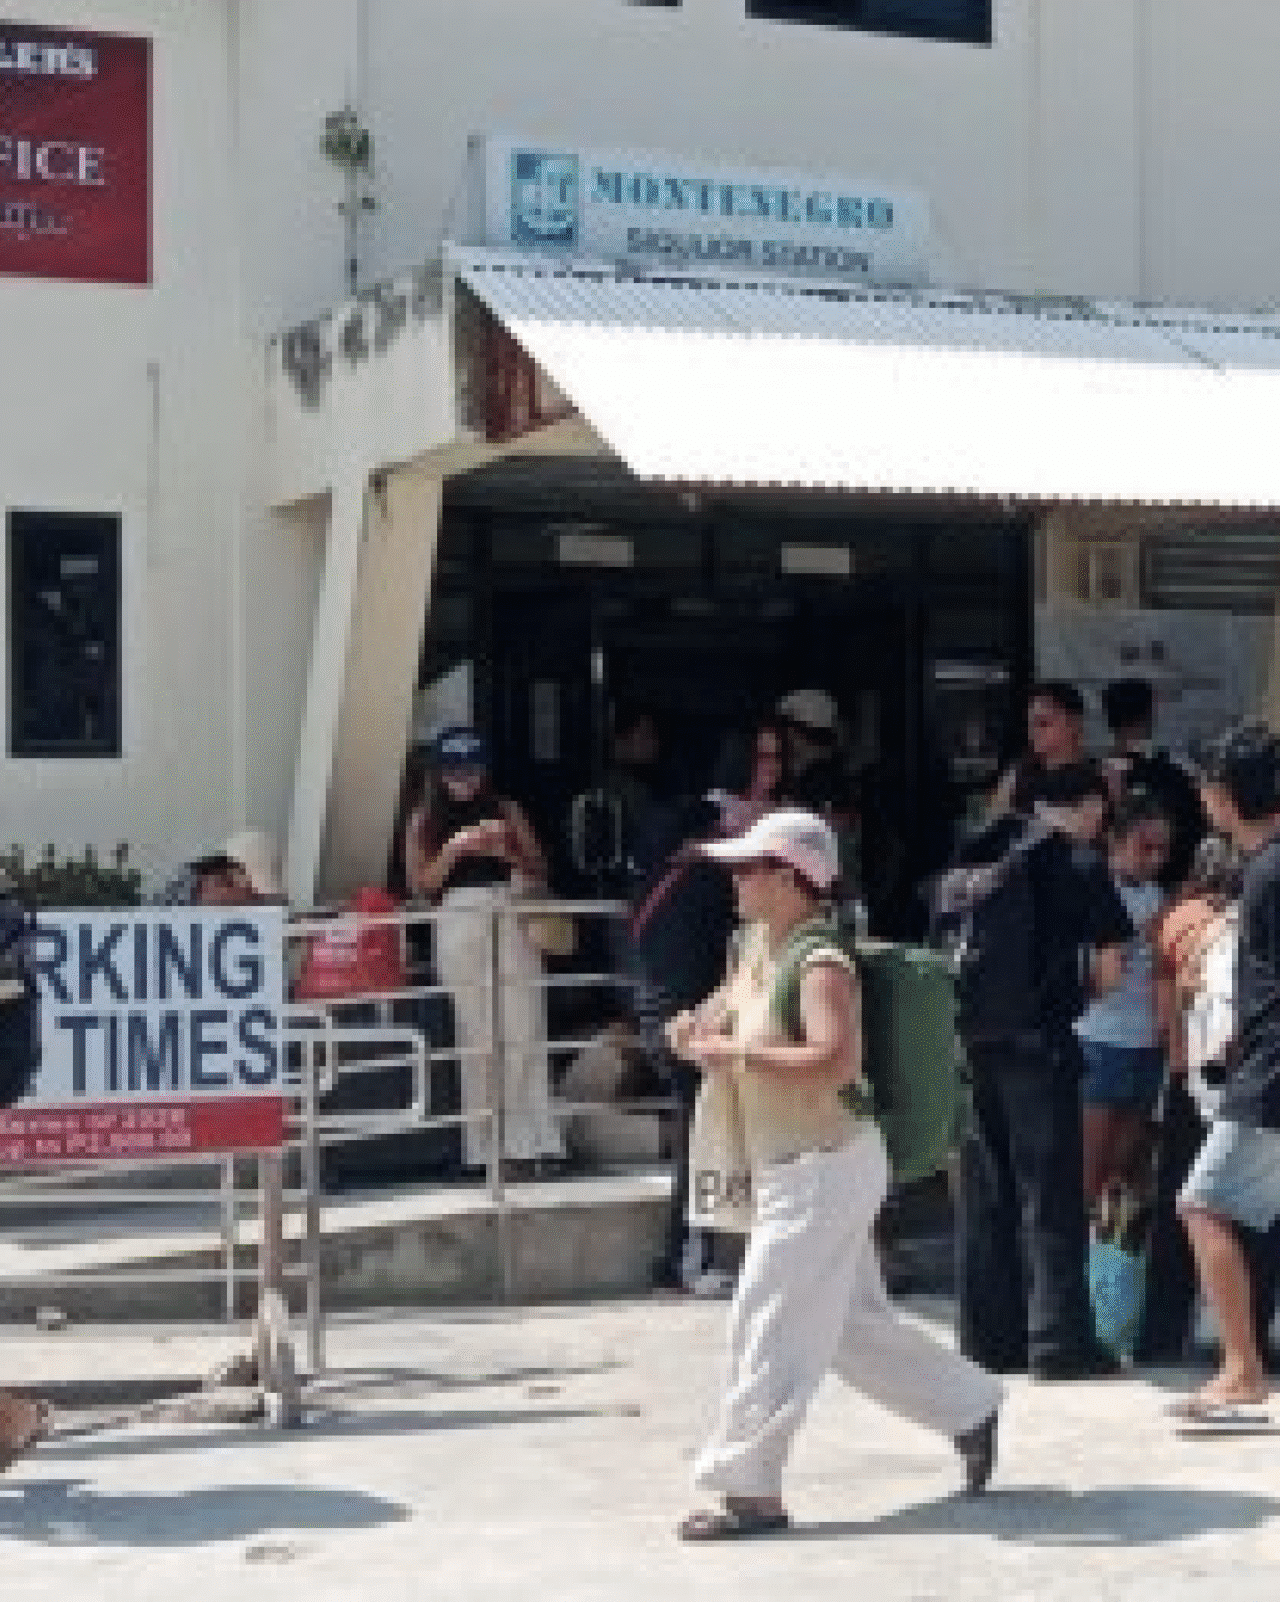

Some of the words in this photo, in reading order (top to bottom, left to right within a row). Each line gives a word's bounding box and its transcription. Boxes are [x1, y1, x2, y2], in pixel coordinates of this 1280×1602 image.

[590, 165, 895, 230] MONTENEGRO
[761, 239, 872, 273] STATION
[54, 1004, 279, 1098] TIMES
